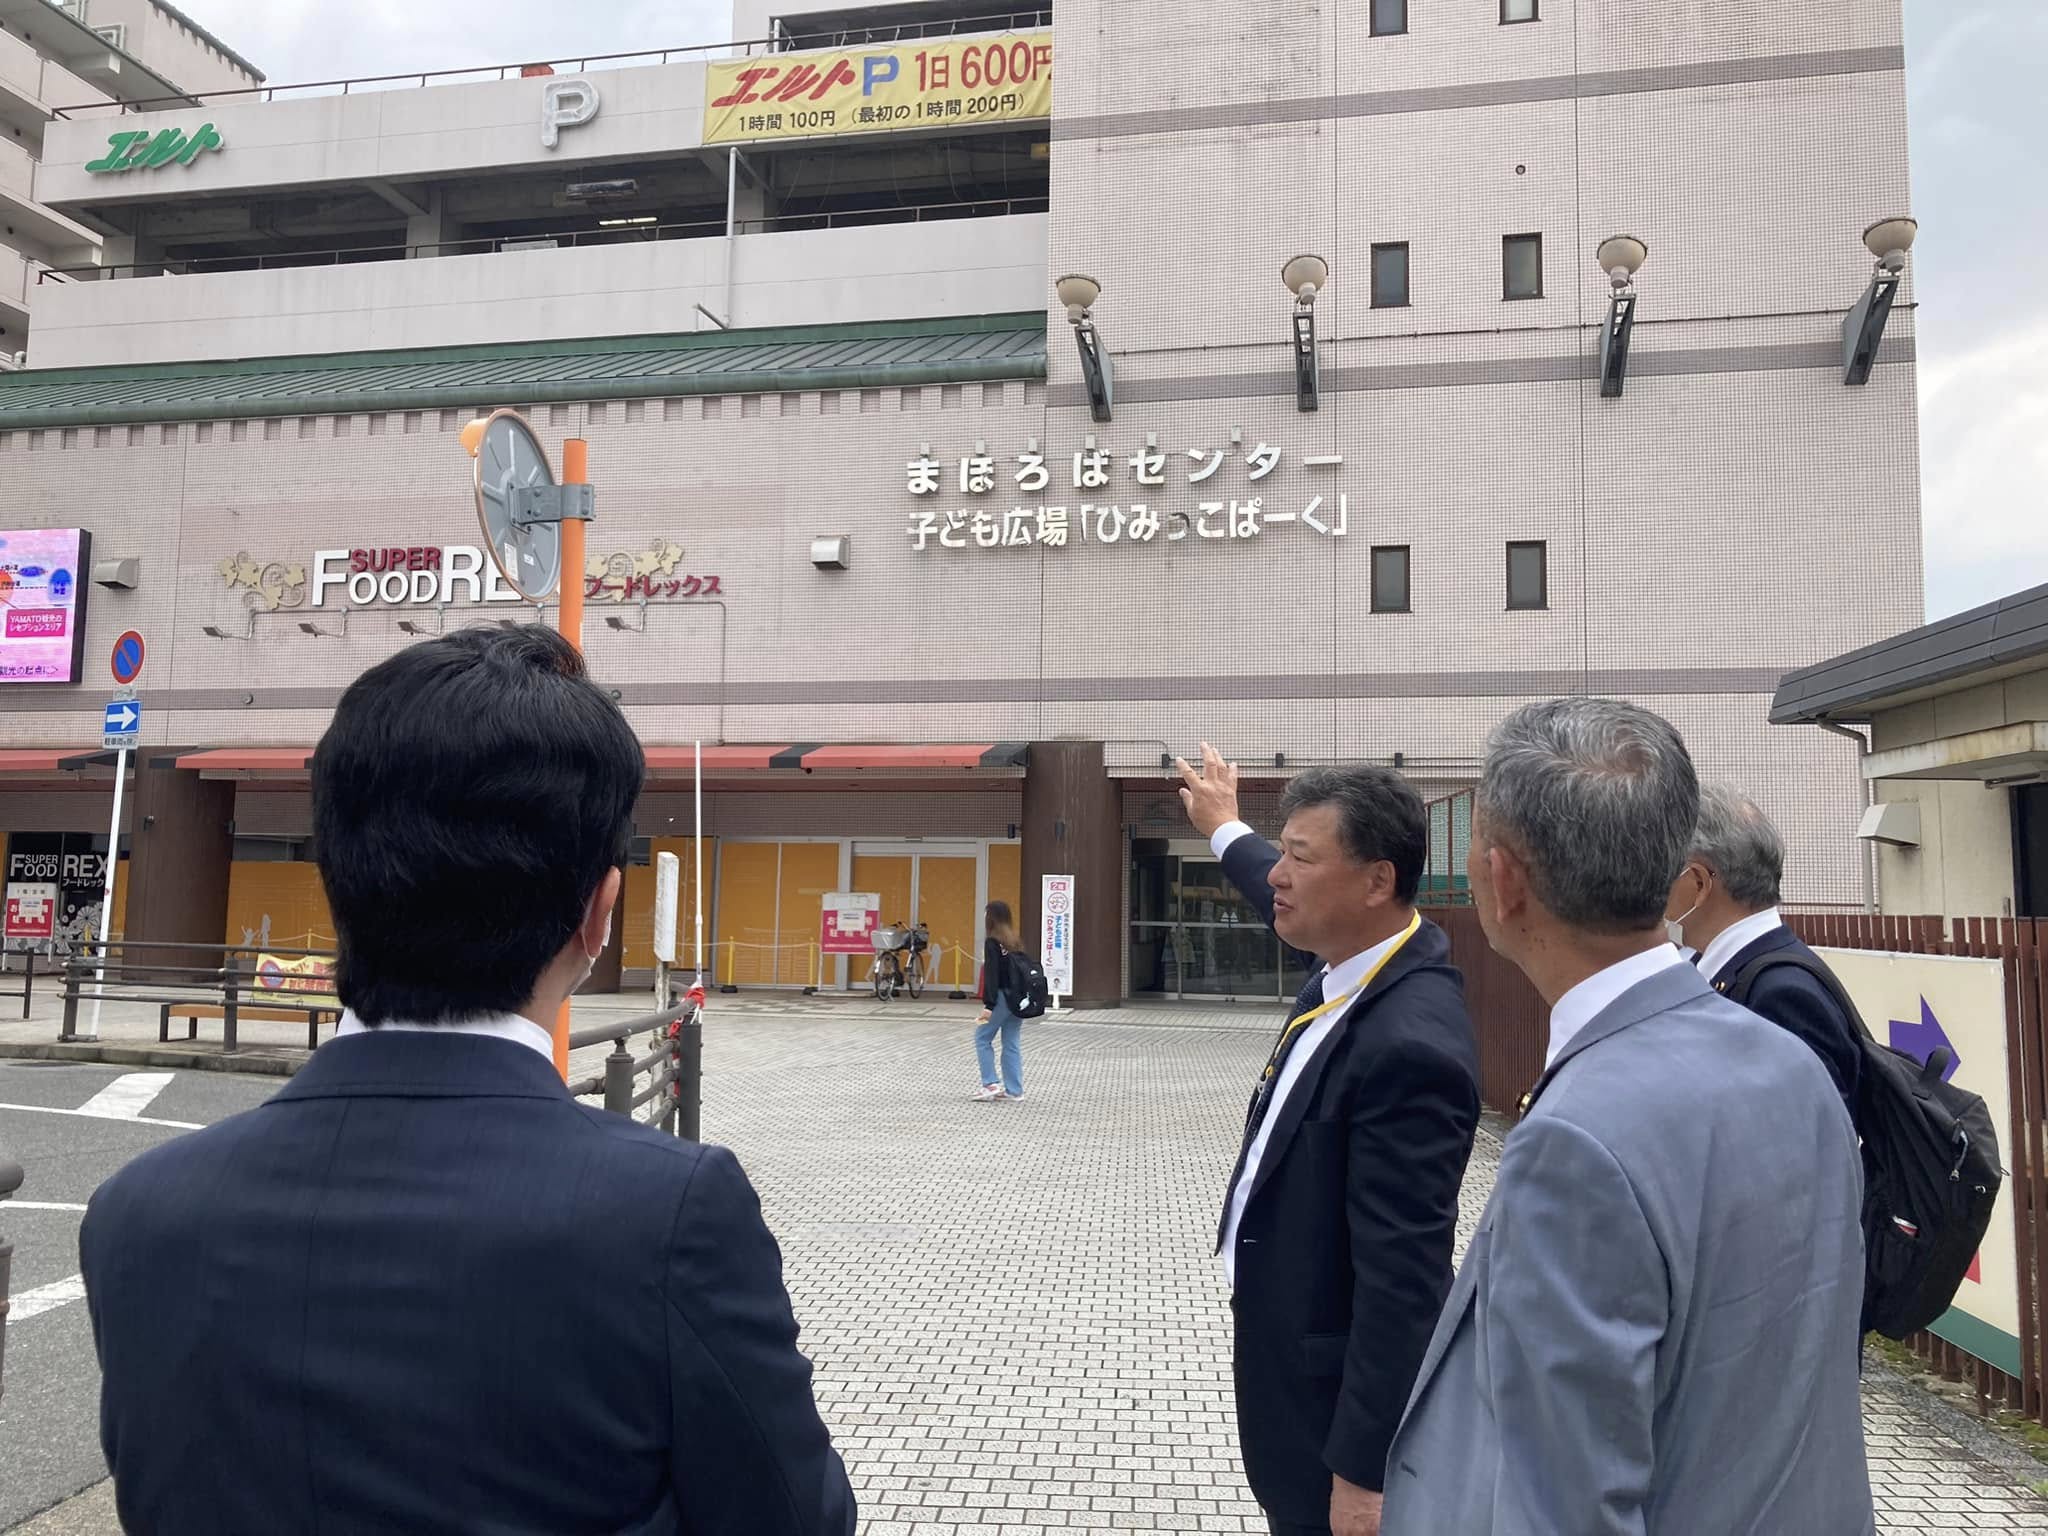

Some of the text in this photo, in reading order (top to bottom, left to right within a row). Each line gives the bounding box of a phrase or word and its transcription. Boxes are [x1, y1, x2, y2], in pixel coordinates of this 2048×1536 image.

[711, 59, 856, 108] エルト
[862, 55, 900, 97] P
[541, 79, 600, 148] P
[739, 113, 783, 132] 1時間
[789, 110, 836, 128] 100円
[84, 122, 224, 174] エルト
[907, 442, 1344, 494] まほろばセンター
[350, 546, 441, 573] SUPER
[584, 574, 722, 599] フードレックス
[25, 854, 59, 865] SUPER
[62, 878, 105, 887] フードレック
